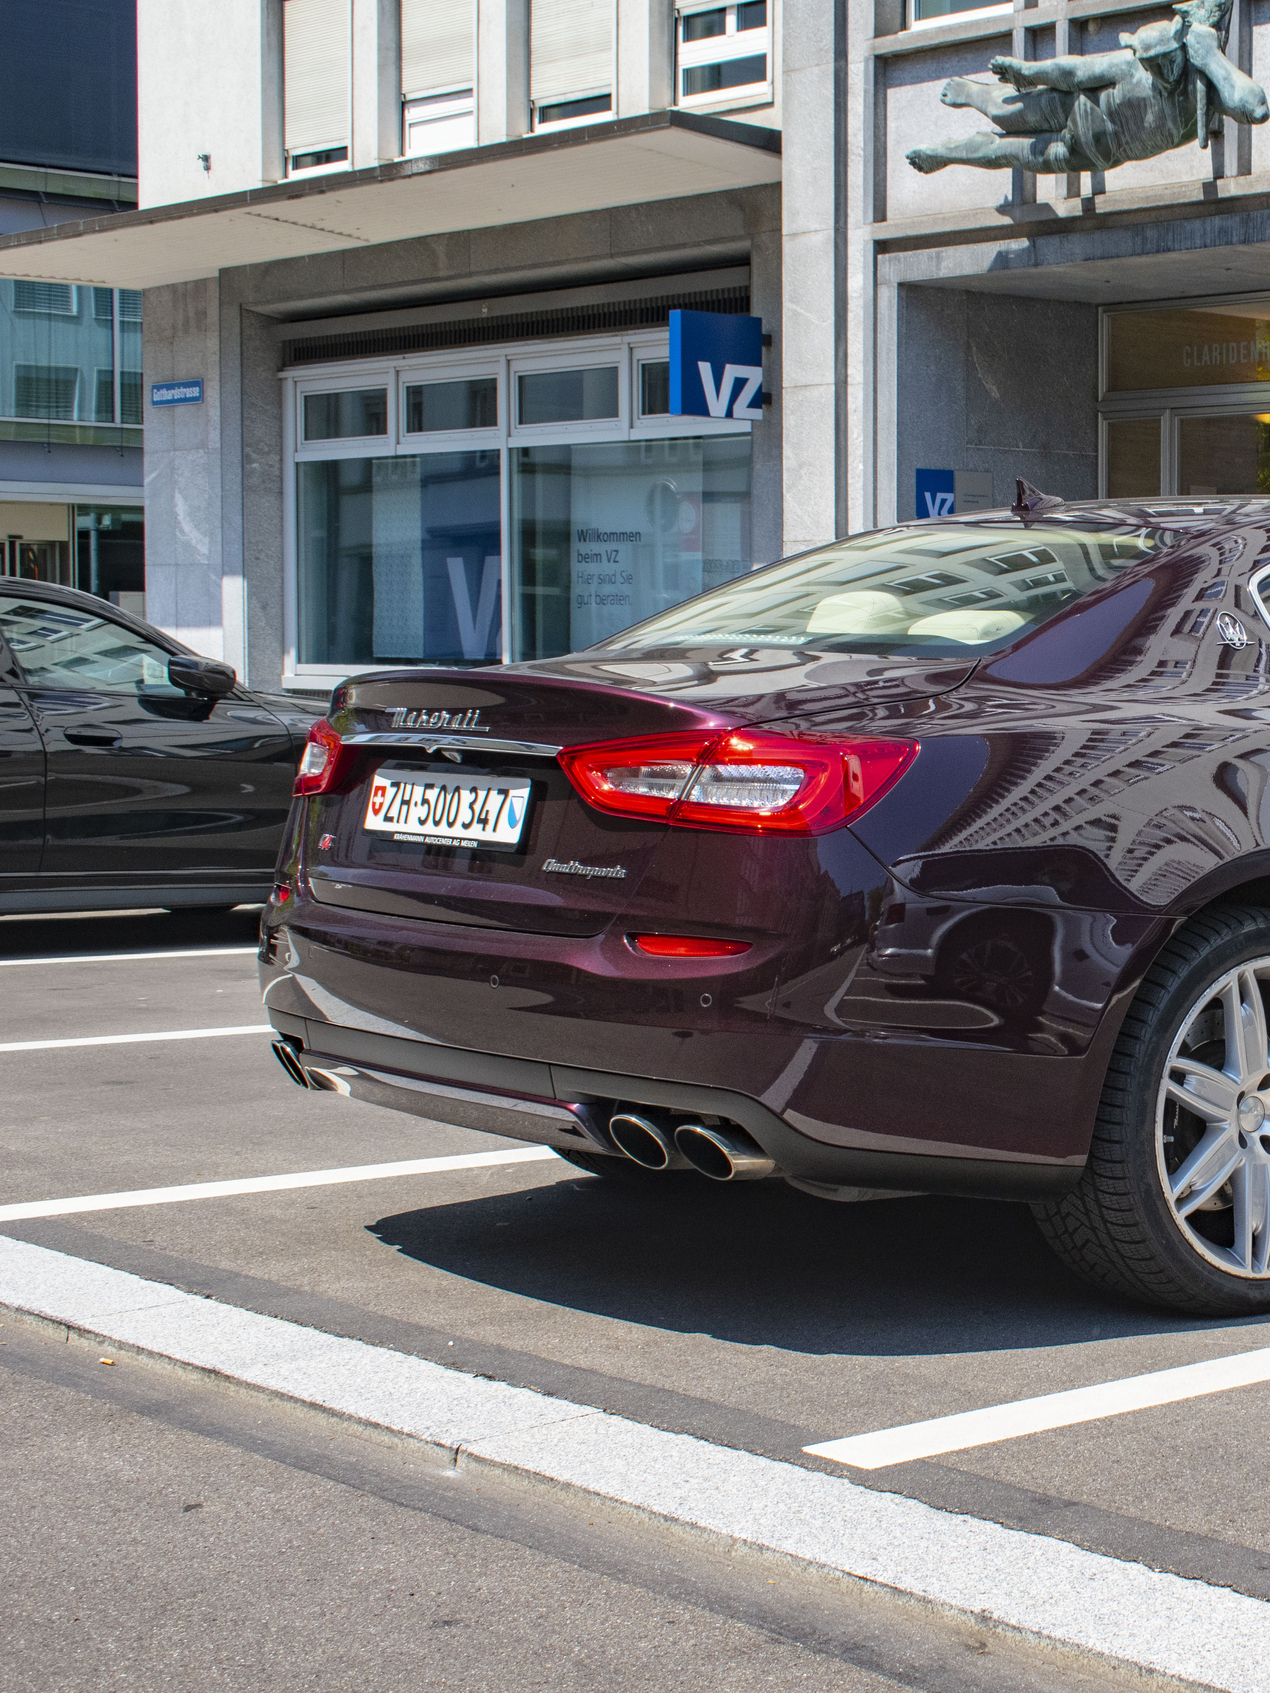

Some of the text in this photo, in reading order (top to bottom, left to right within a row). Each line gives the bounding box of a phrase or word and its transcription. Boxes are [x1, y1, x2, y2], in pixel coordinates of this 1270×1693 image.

[153, 386, 200, 401] Gotthardstrasse
[698, 361, 763, 420] VZ
[924, 491, 954, 518] VZ
[577, 529, 641, 543] Willkommen
[577, 550, 619, 563] beim VZ
[577, 570, 633, 585] Hier sind Sie
[446, 555, 502, 659] V
[576, 590, 632, 608] gut beraten.
[385, 708, 490, 732] Maserati
